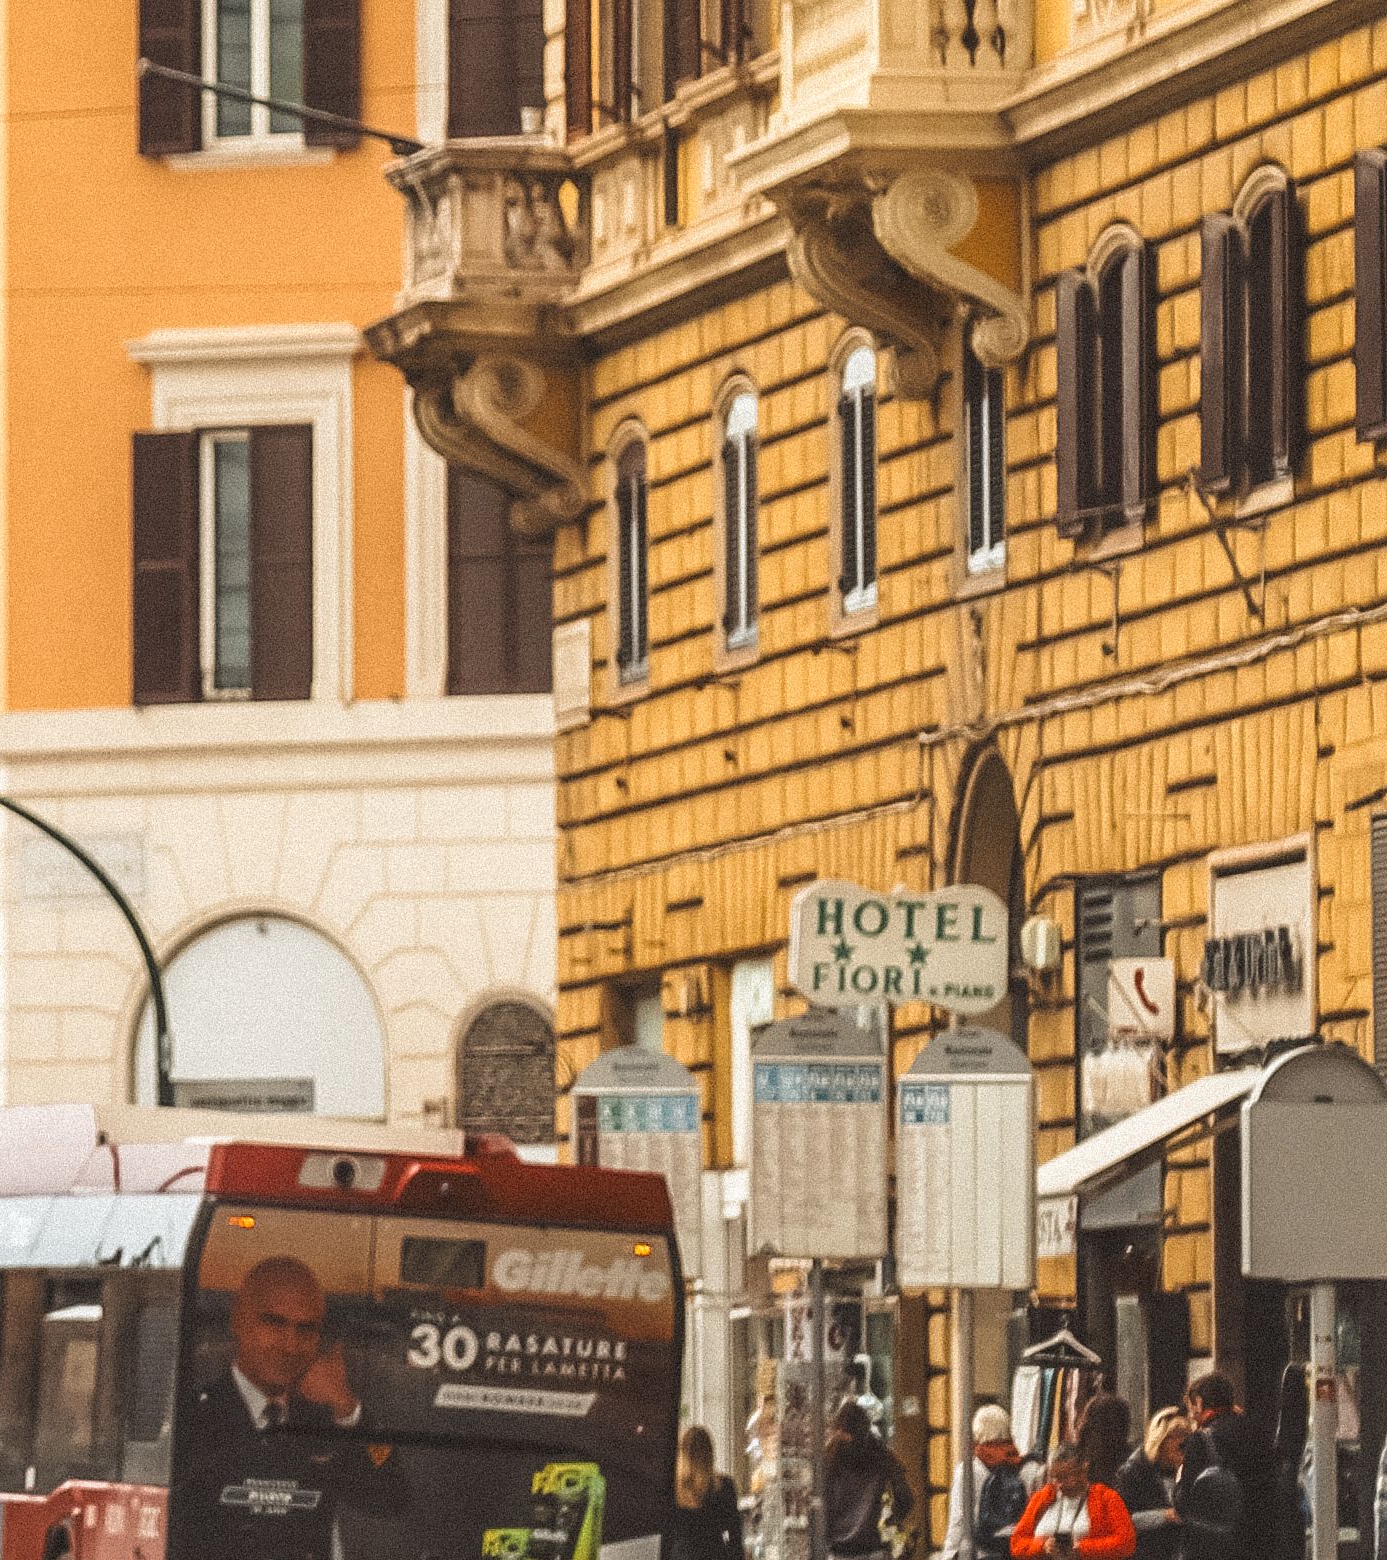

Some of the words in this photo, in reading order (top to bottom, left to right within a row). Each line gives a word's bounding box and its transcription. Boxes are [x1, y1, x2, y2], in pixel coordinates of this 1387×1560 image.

[817, 898, 997, 944] HOTEL
[812, 962, 921, 996] FIORI
[493, 1250, 669, 1303] Gillette
[408, 1323, 477, 1371] 30
[485, 1332, 626, 1361] RASATURE
